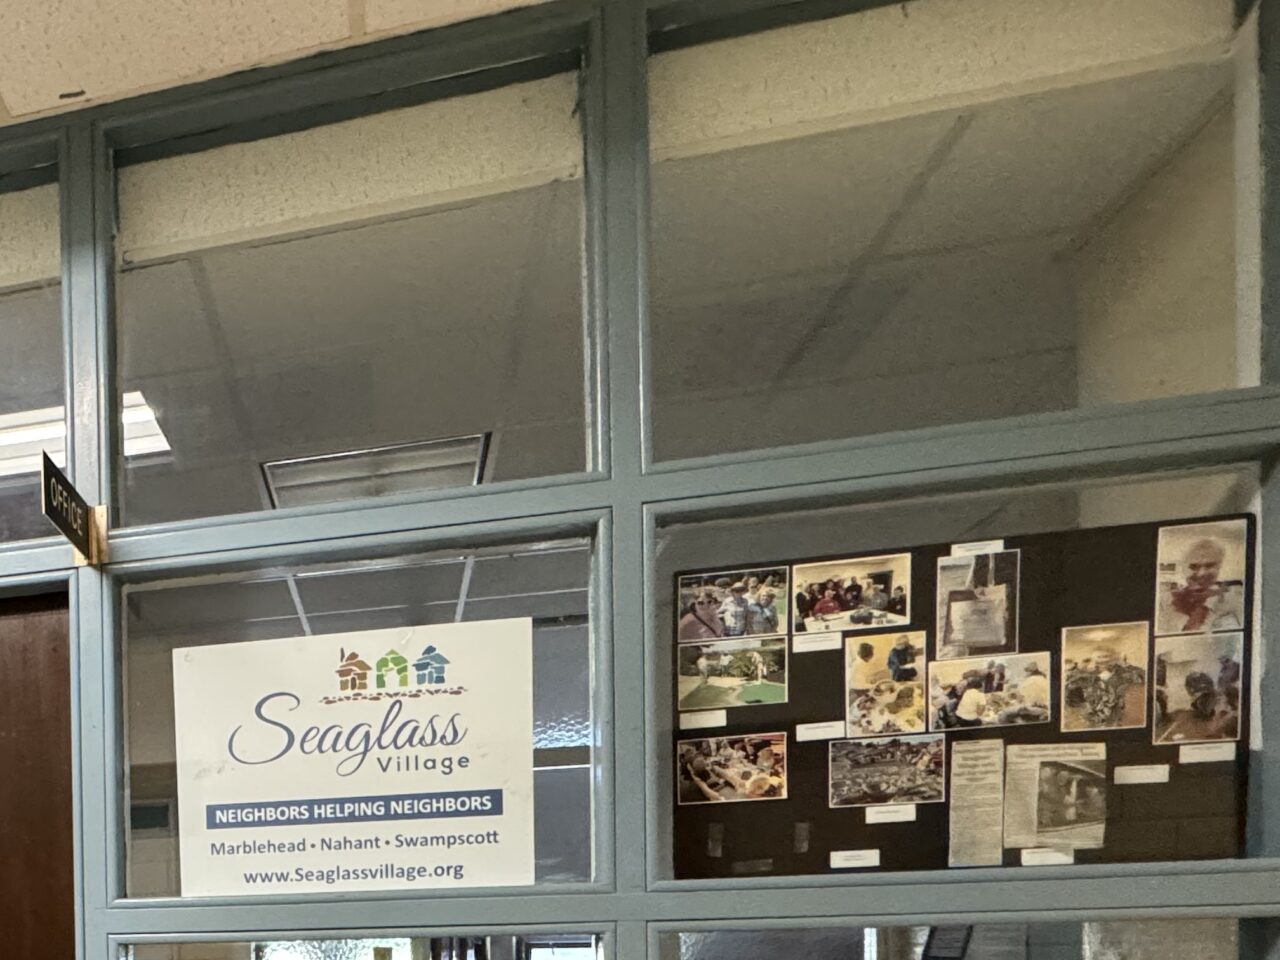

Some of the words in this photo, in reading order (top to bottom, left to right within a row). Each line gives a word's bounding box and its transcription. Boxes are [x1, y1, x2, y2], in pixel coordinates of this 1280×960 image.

[50, 477, 83, 536] OFFICE
[227, 690, 469, 777] Seaglass
[376, 754, 471, 775] Village
[215, 805, 310, 825] NEIGHBORS
[313, 801, 385, 821] HELPING
[390, 795, 492, 816] NEIGHBORS
[210, 838, 306, 856] Marblehead
[320, 836, 381, 852] Nahant
[394, 830, 499, 850] Swampscott
[243, 864, 464, 885] www.Seaglassvillage.org
